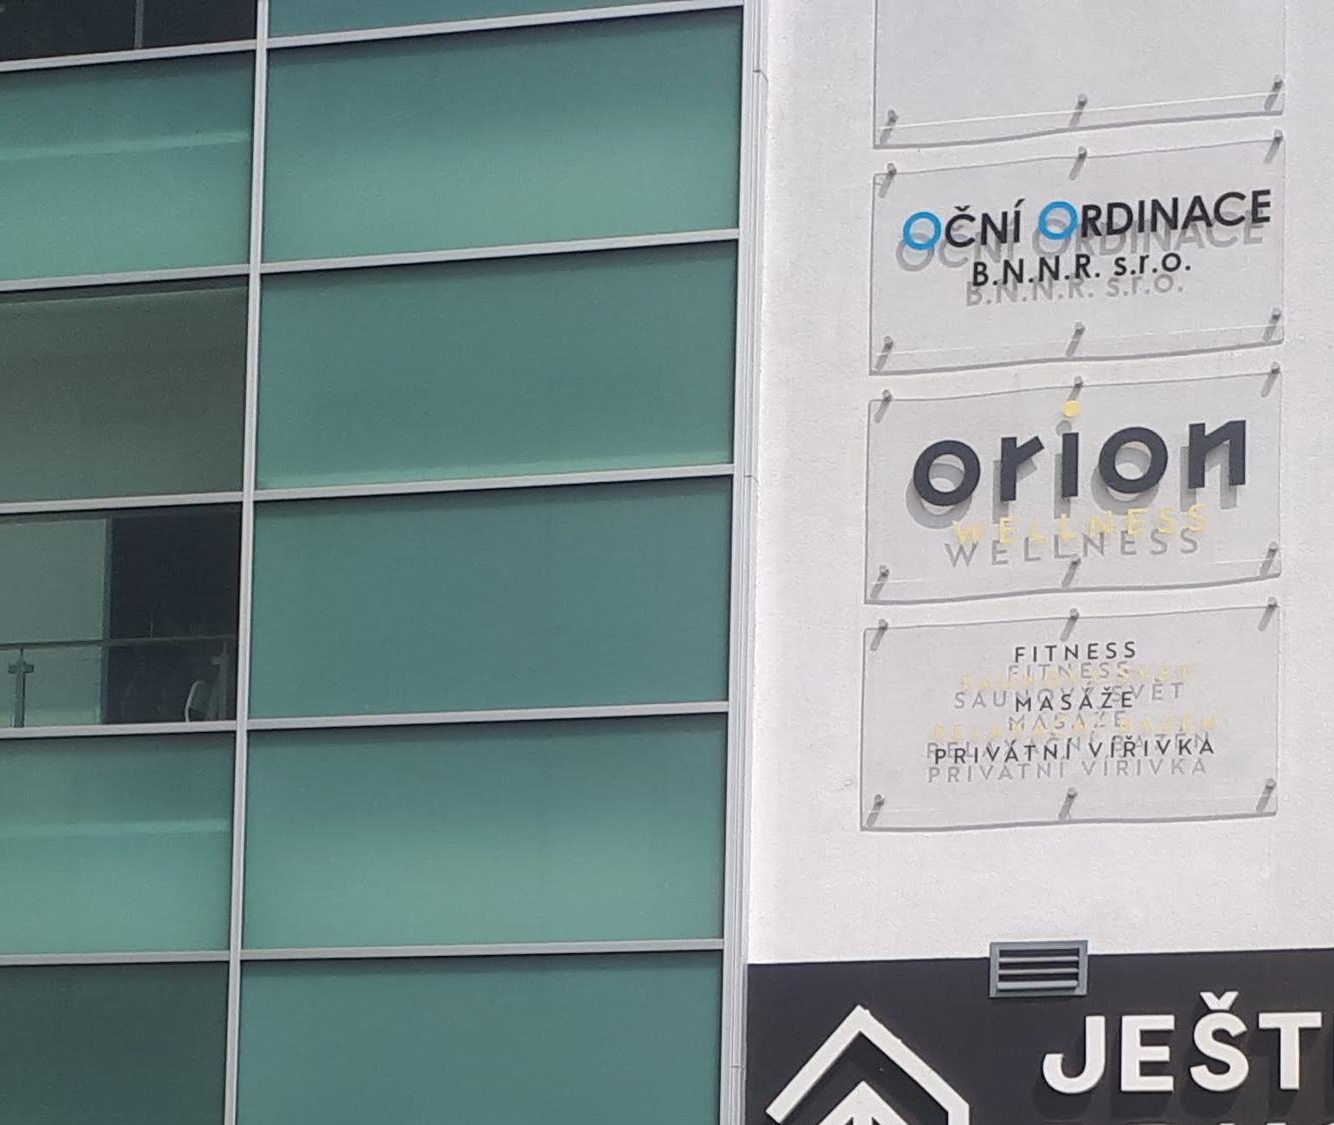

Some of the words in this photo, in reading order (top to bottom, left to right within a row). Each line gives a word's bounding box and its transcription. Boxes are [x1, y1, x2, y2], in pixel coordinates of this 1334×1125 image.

[903, 199, 1026, 250] OČNÍ
[1038, 189, 1271, 239] ORDINACE
[972, 253, 1100, 287] B.N.N.R.
[1113, 251, 1192, 276] s.r.o.
[913, 399, 1246, 506] orion
[952, 504, 1209, 543] WELLNESS
[1015, 641, 1135, 663] FITNESS
[1015, 687, 1133, 712] MASÁŽE
[934, 738, 1072, 765] PRIVÁTNÍ
[1088, 735, 1214, 759] VÍŘIVKA
